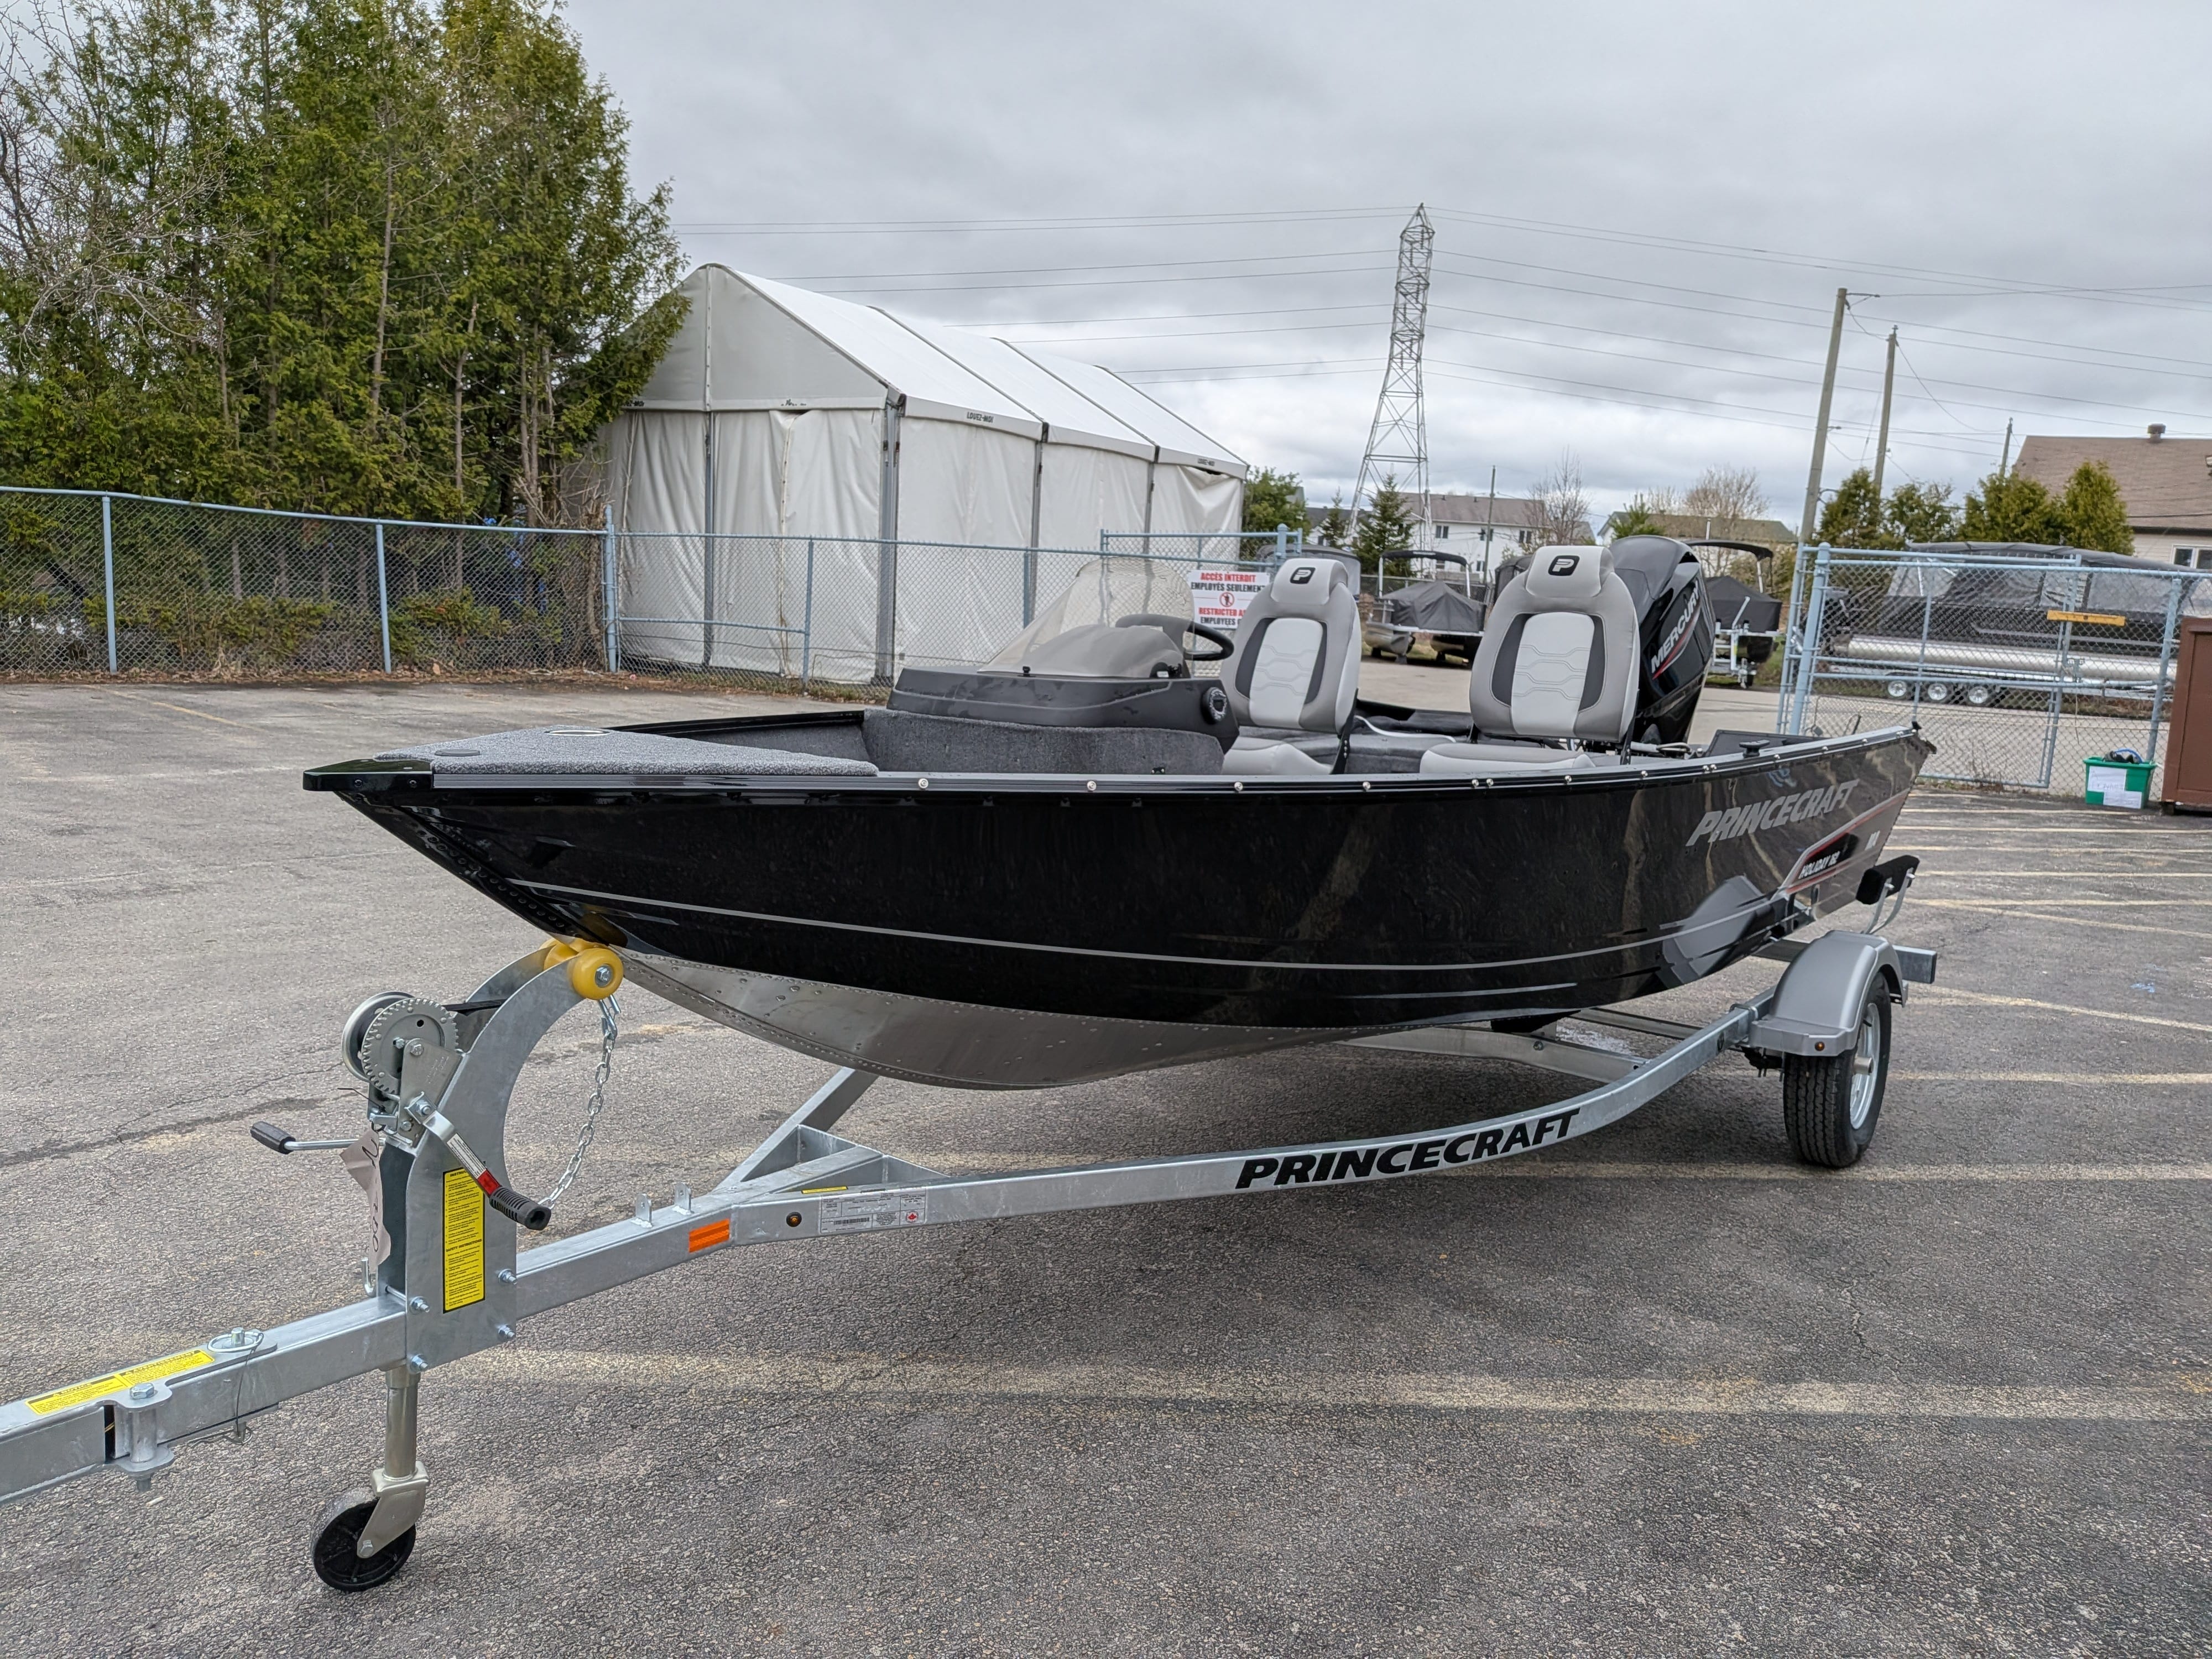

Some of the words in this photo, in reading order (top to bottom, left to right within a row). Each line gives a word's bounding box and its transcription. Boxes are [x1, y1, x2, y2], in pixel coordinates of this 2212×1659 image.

[1201, 572, 1223, 582] ACCÈS
[1224, 573, 1257, 583] INTERDIT
[1191, 582, 1225, 591] EMPLOYÉS
[1198, 607, 1238, 617] RESTRICTED
[1200, 617, 1236, 626] EMPLOYEES
[1651, 580, 1699, 673] MERCURY
[1685, 779, 1860, 847] PRINCECRAFT
[1234, 1107, 1580, 1190] PRINCECRAFT
